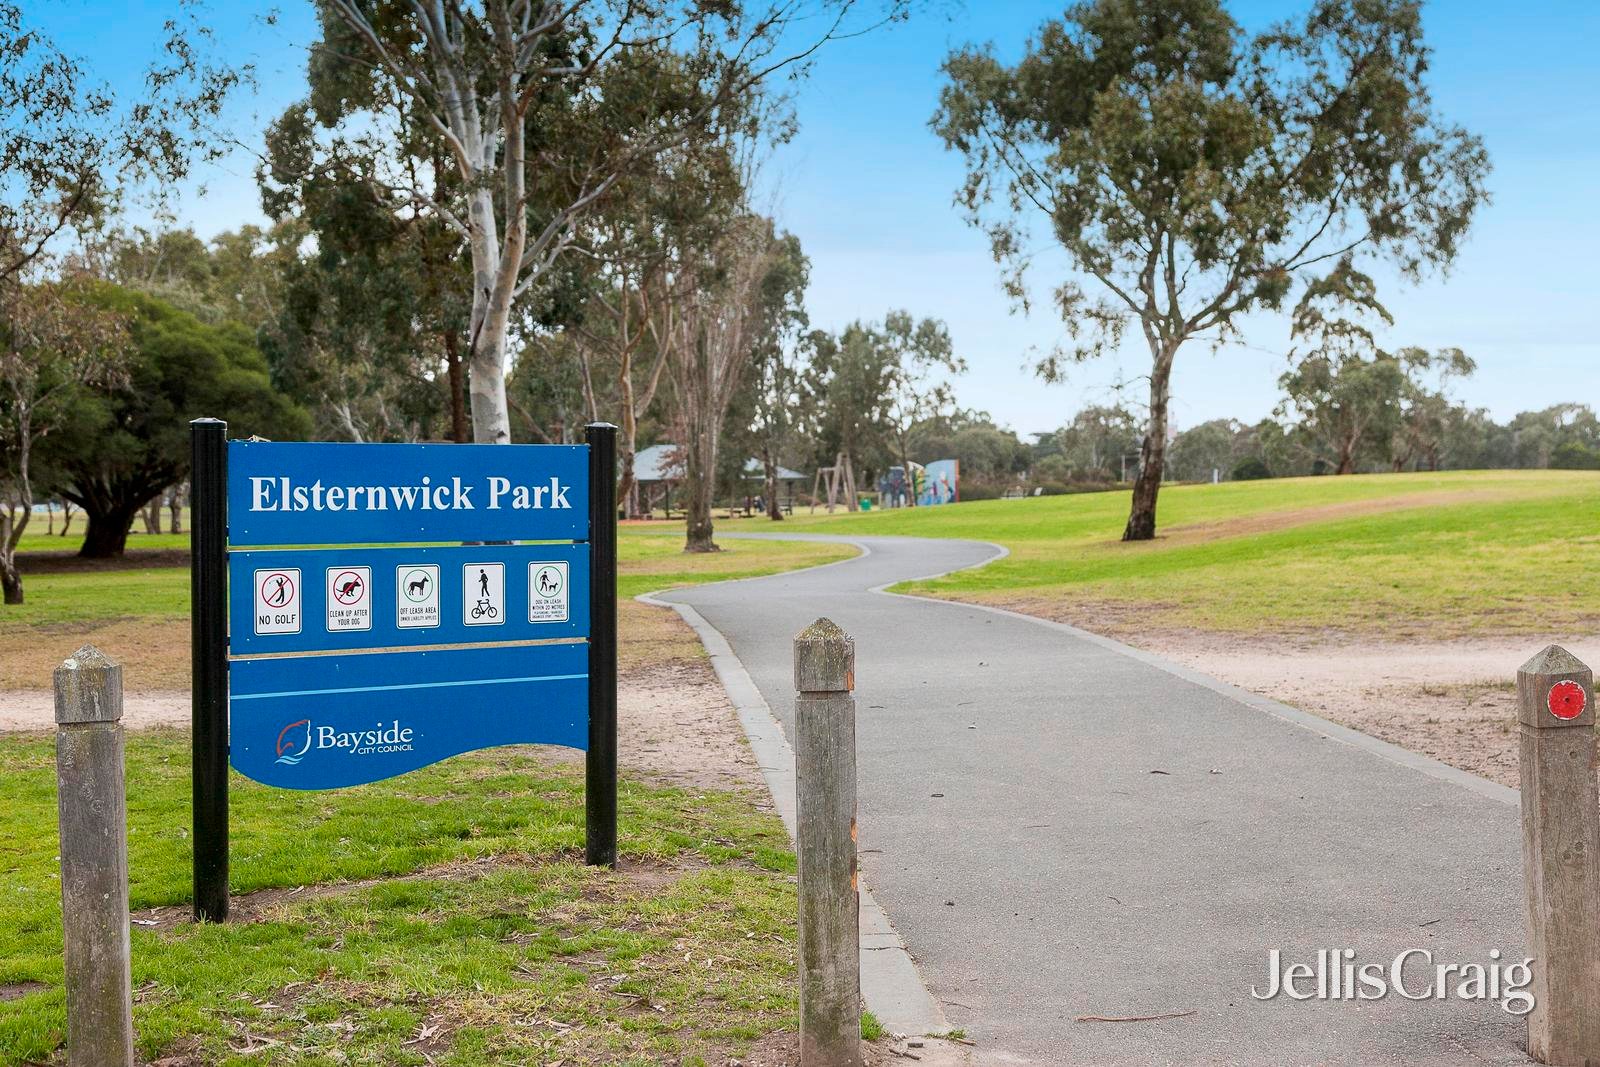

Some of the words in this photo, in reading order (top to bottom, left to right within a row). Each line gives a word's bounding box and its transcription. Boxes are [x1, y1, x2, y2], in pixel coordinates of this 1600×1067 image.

[248, 476, 475, 512] Elsternwick
[486, 476, 572, 511] Park
[330, 610, 344, 618] CLEAN
[354, 609, 368, 617] AFTER
[400, 607, 408, 615] OFF
[410, 607, 423, 615] LEASH
[259, 615, 271, 625] NO
[275, 614, 296, 624] GOLF
[316, 720, 413, 754] Bayside
[358, 747, 375, 755] CITY
[377, 744, 414, 753] COUNCIL
